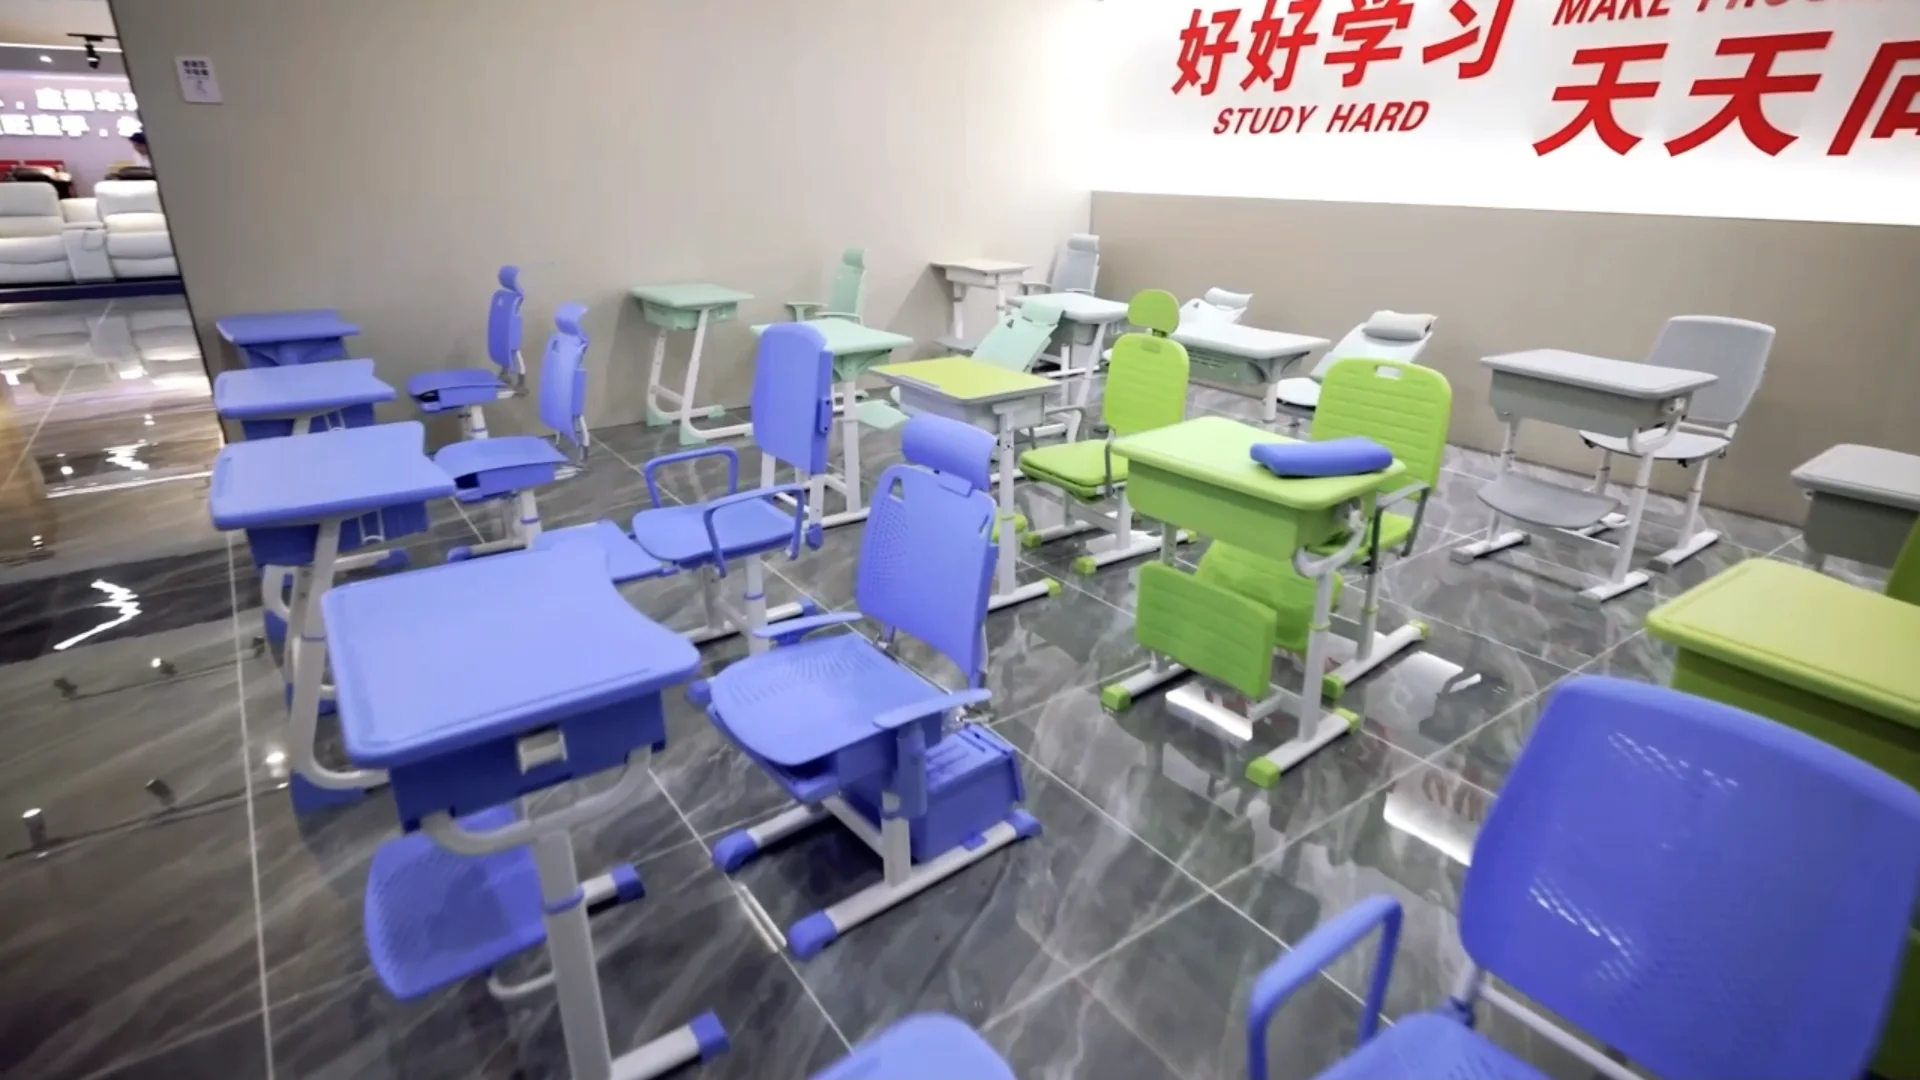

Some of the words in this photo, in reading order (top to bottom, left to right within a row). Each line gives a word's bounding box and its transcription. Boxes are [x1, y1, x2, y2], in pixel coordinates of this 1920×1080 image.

[1172, 0, 1517, 97] 好好学习
[1213, 105, 1318, 135] STUDY
[1326, 100, 1431, 133] HARD
